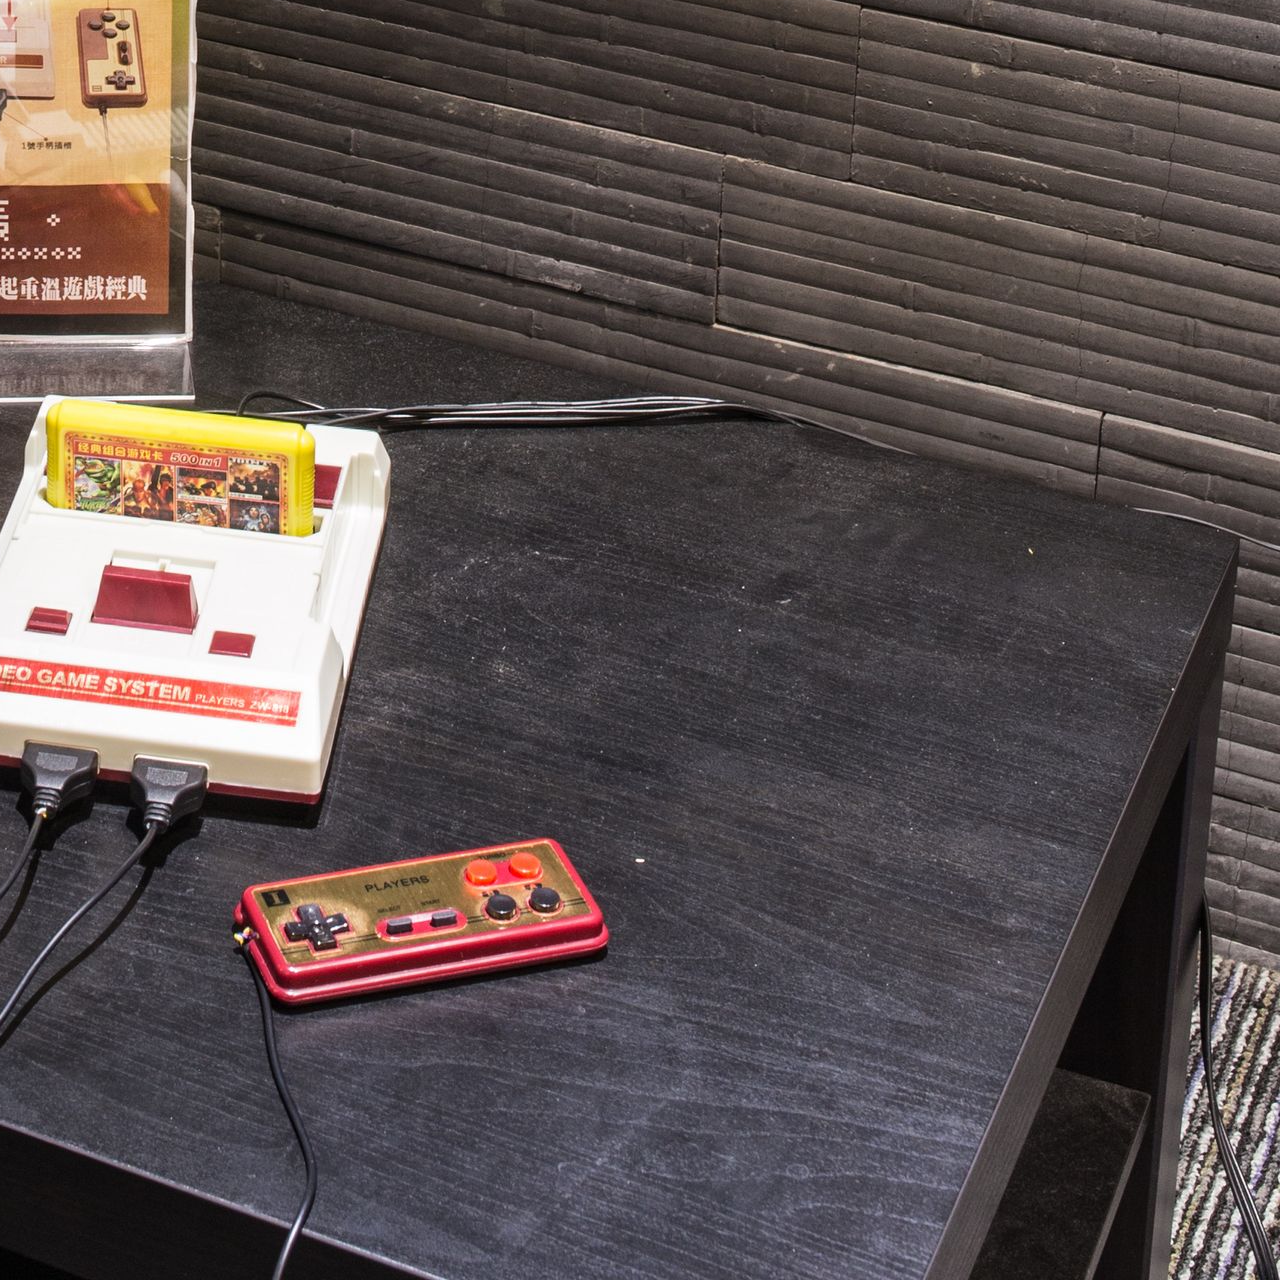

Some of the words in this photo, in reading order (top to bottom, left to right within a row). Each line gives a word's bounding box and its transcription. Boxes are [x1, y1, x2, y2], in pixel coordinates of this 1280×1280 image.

[36, 668, 99, 691] GAME
[103, 676, 191, 702] SYSTEM
[195, 693, 246, 709] PLAYERS
[364, 875, 431, 893] PLAYERS
